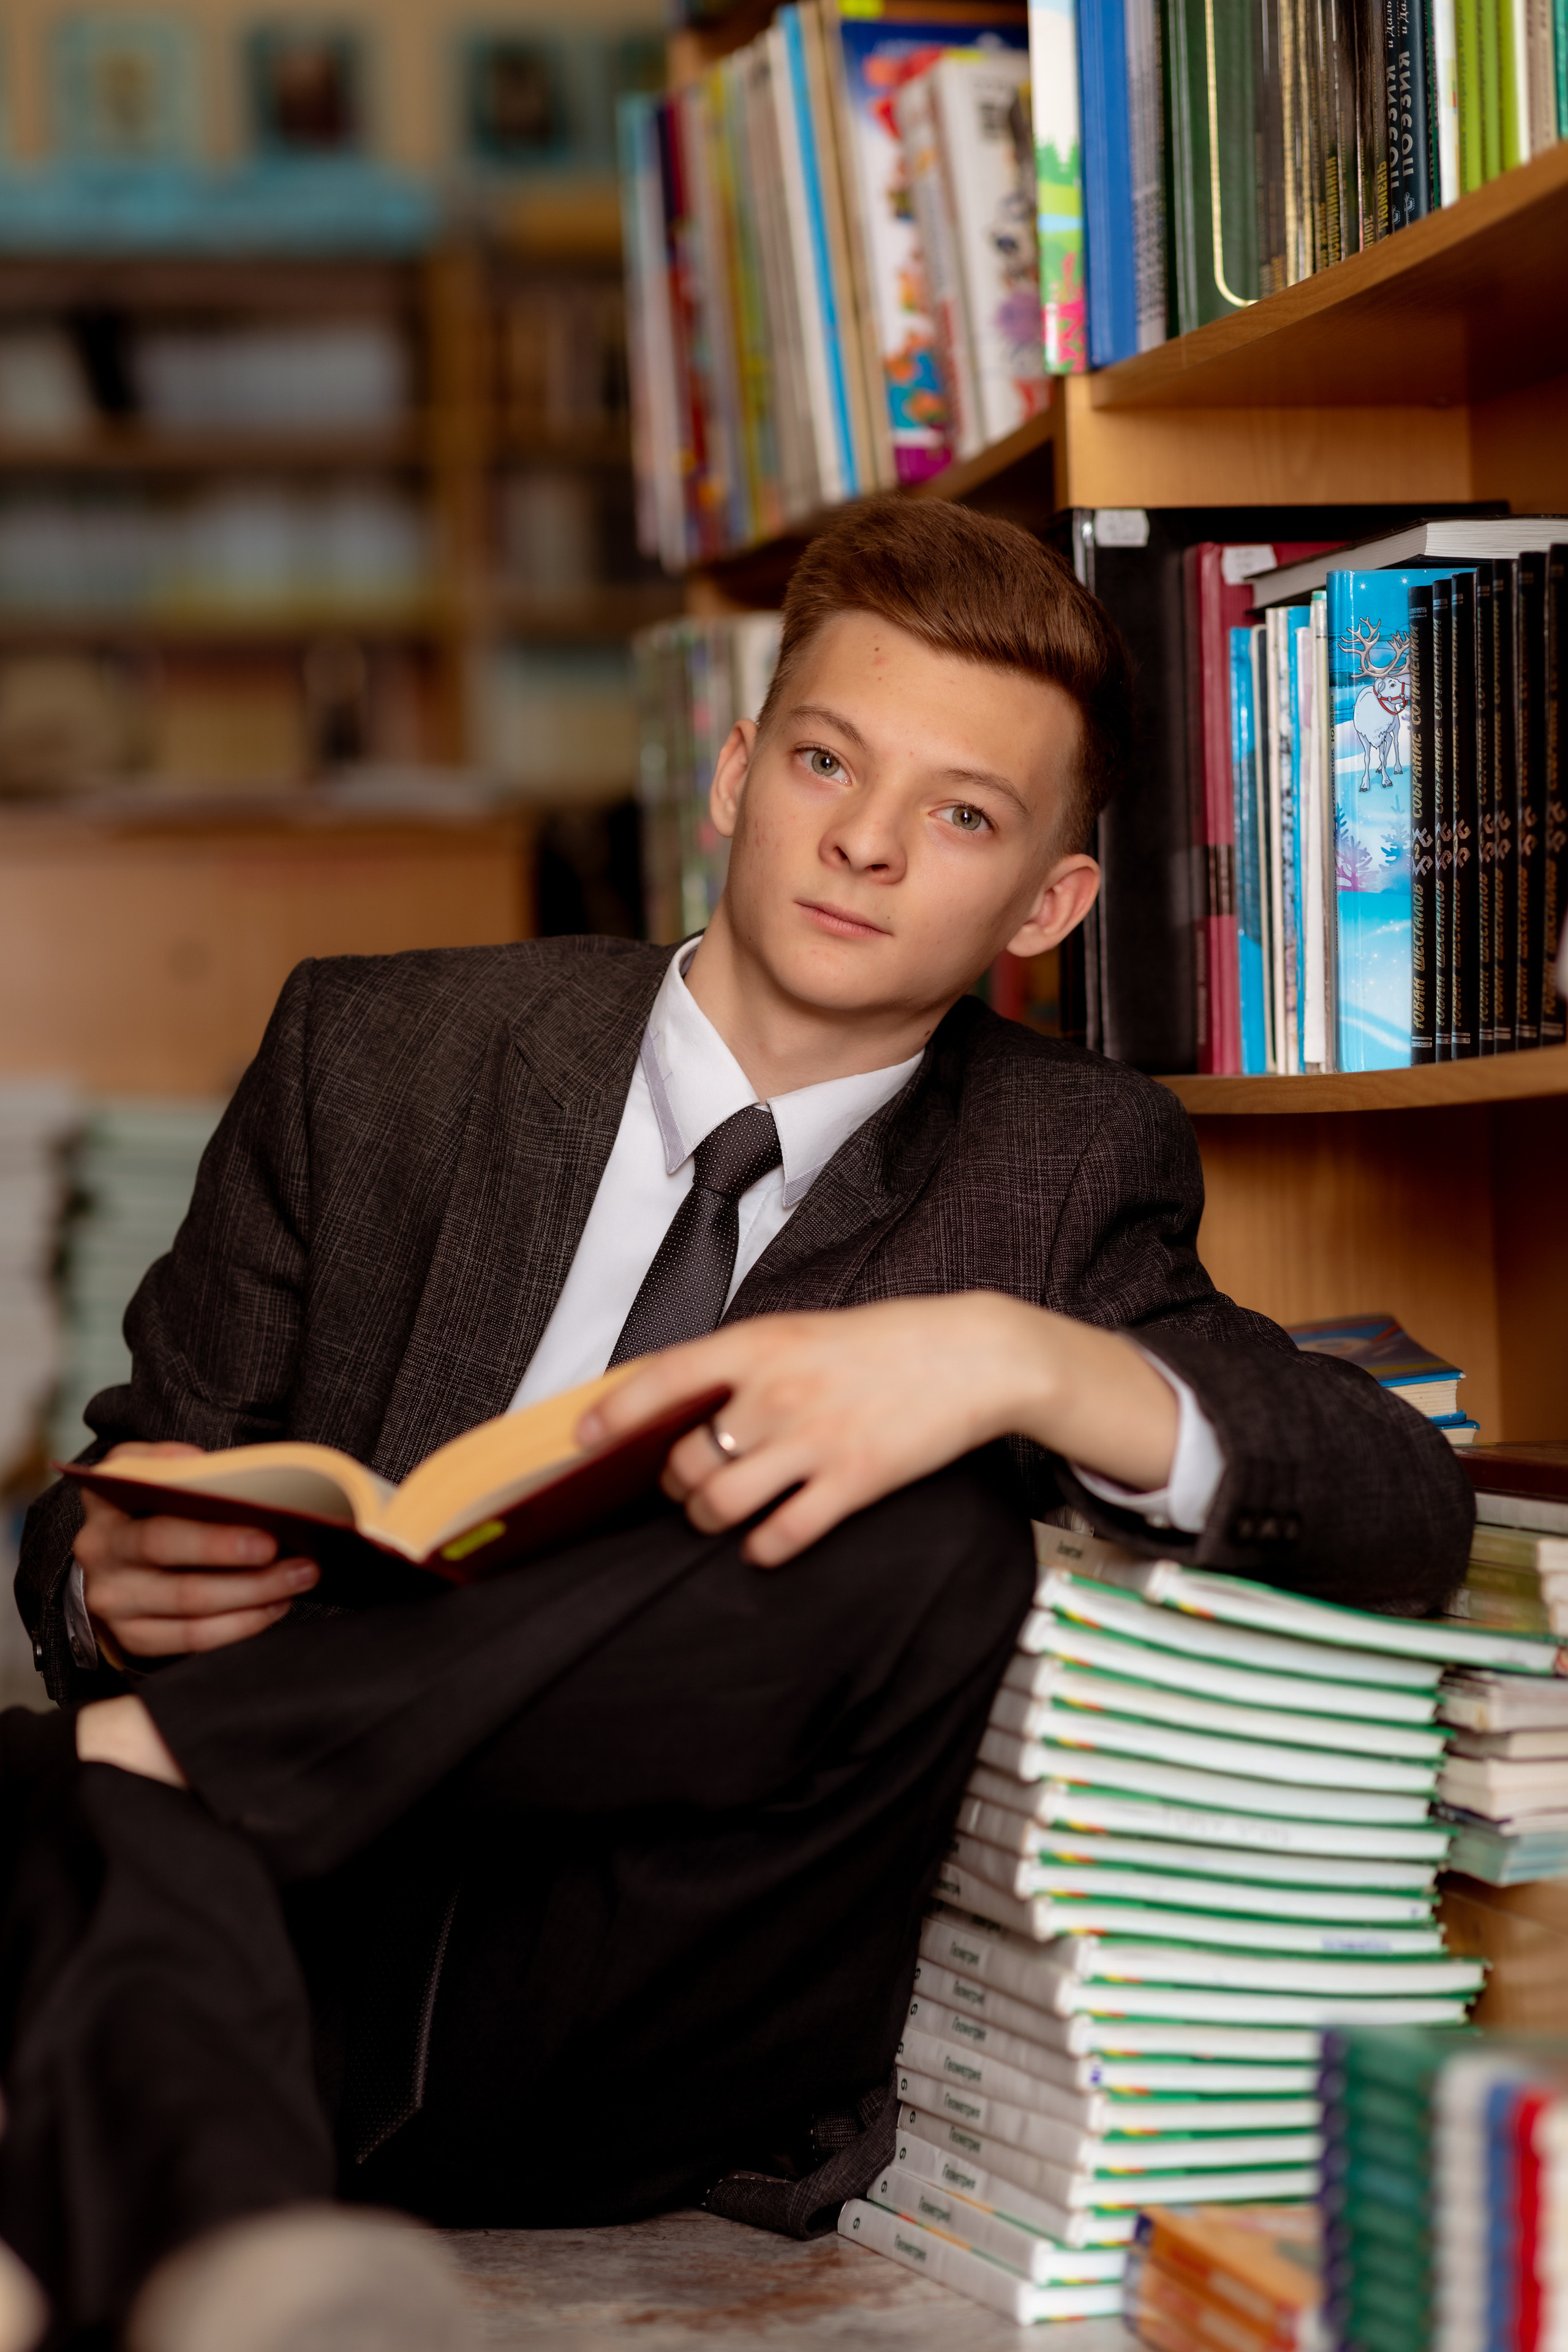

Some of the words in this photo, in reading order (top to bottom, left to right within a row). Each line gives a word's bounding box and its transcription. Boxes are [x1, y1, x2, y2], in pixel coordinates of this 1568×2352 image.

[1386, 64, 1400, 189] ПОЭЗИЯ
[1398, 51, 1414, 176] ПОЭЗИЯ
[1376, 160, 1389, 233] ТЮМЕНЬ
[1412, 729, 1423, 819] СОБРАНИЕ
[1412, 883, 1425, 971] ШЕСТАЛОВ
[1436, 878, 1446, 968] ШЕСТАЛОВ
[1413, 976, 1425, 1029] ЮВАН
[1436, 974, 1446, 1026] ЮВАН
